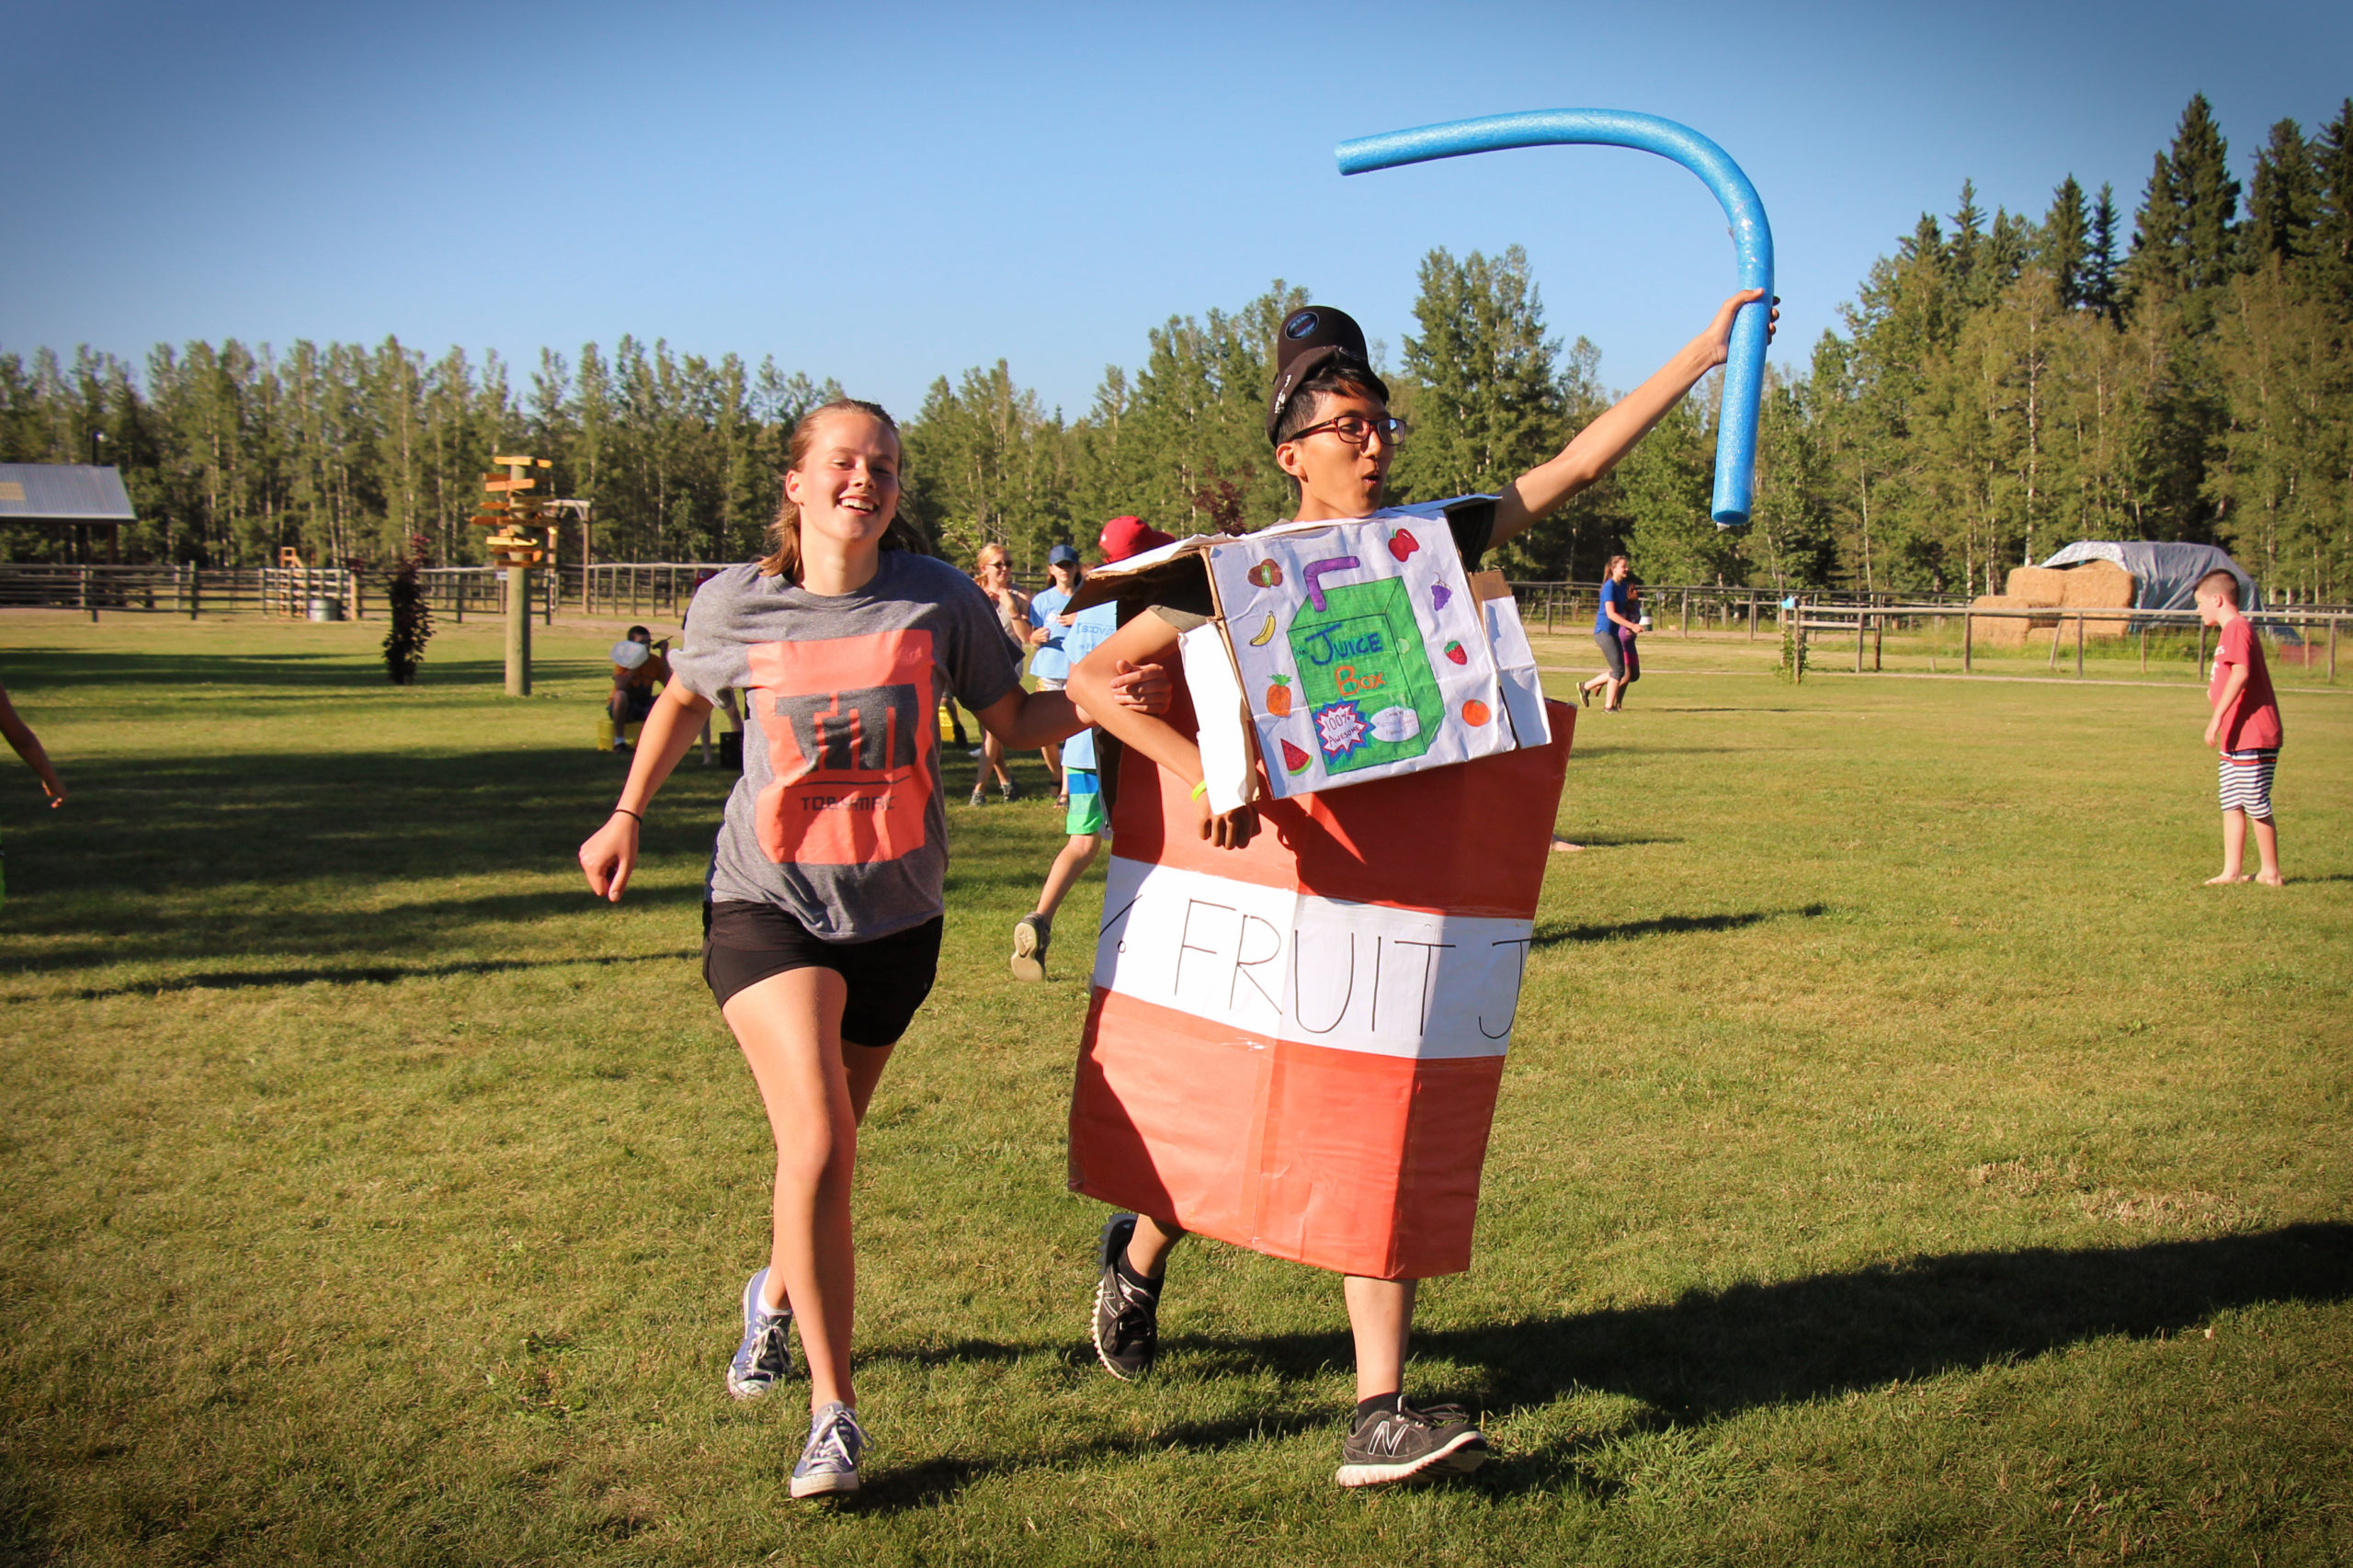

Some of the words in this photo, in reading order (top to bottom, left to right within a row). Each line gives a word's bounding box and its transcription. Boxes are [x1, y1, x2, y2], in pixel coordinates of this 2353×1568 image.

[1305, 622, 1383, 665] JUICE
[1324, 710, 1351, 733] 100%
[1328, 724, 1362, 747] AWESOME
[801, 795, 897, 812] TOBMAC
[1174, 897, 1456, 1039] FRUIT
